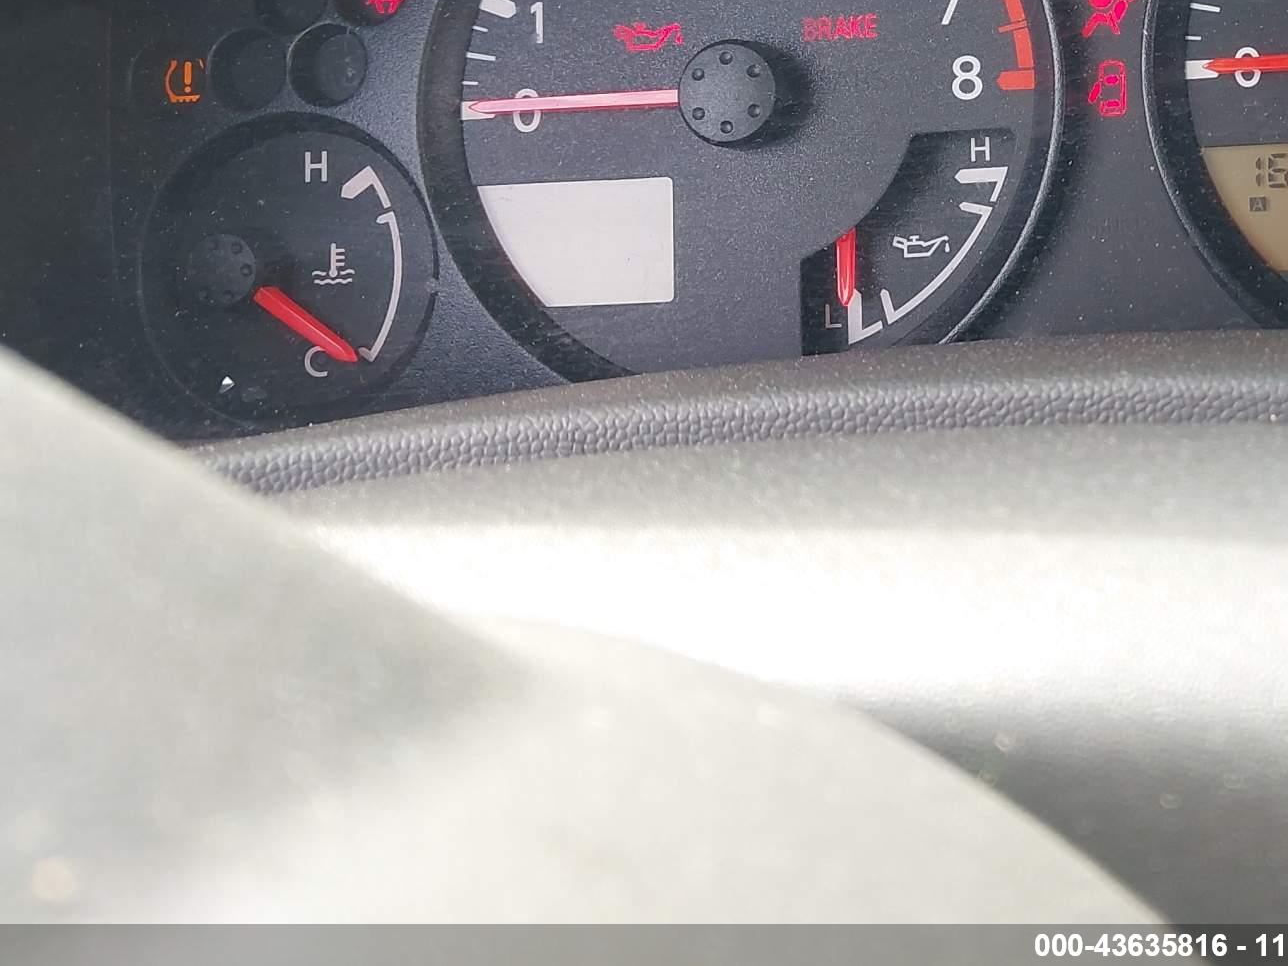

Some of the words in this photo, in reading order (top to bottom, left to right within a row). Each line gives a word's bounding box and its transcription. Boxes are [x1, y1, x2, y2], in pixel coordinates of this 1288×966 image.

[530, 2, 543, 44] 1
[803, 13, 879, 42] BRAKE
[951, 56, 982, 100] 8
[1234, 46, 1262, 88] 0
[513, 89, 541, 132] 0
[970, 137, 991, 161] H
[304, 151, 328, 182] H
[825, 304, 842, 329] L
[304, 345, 329, 377] C
